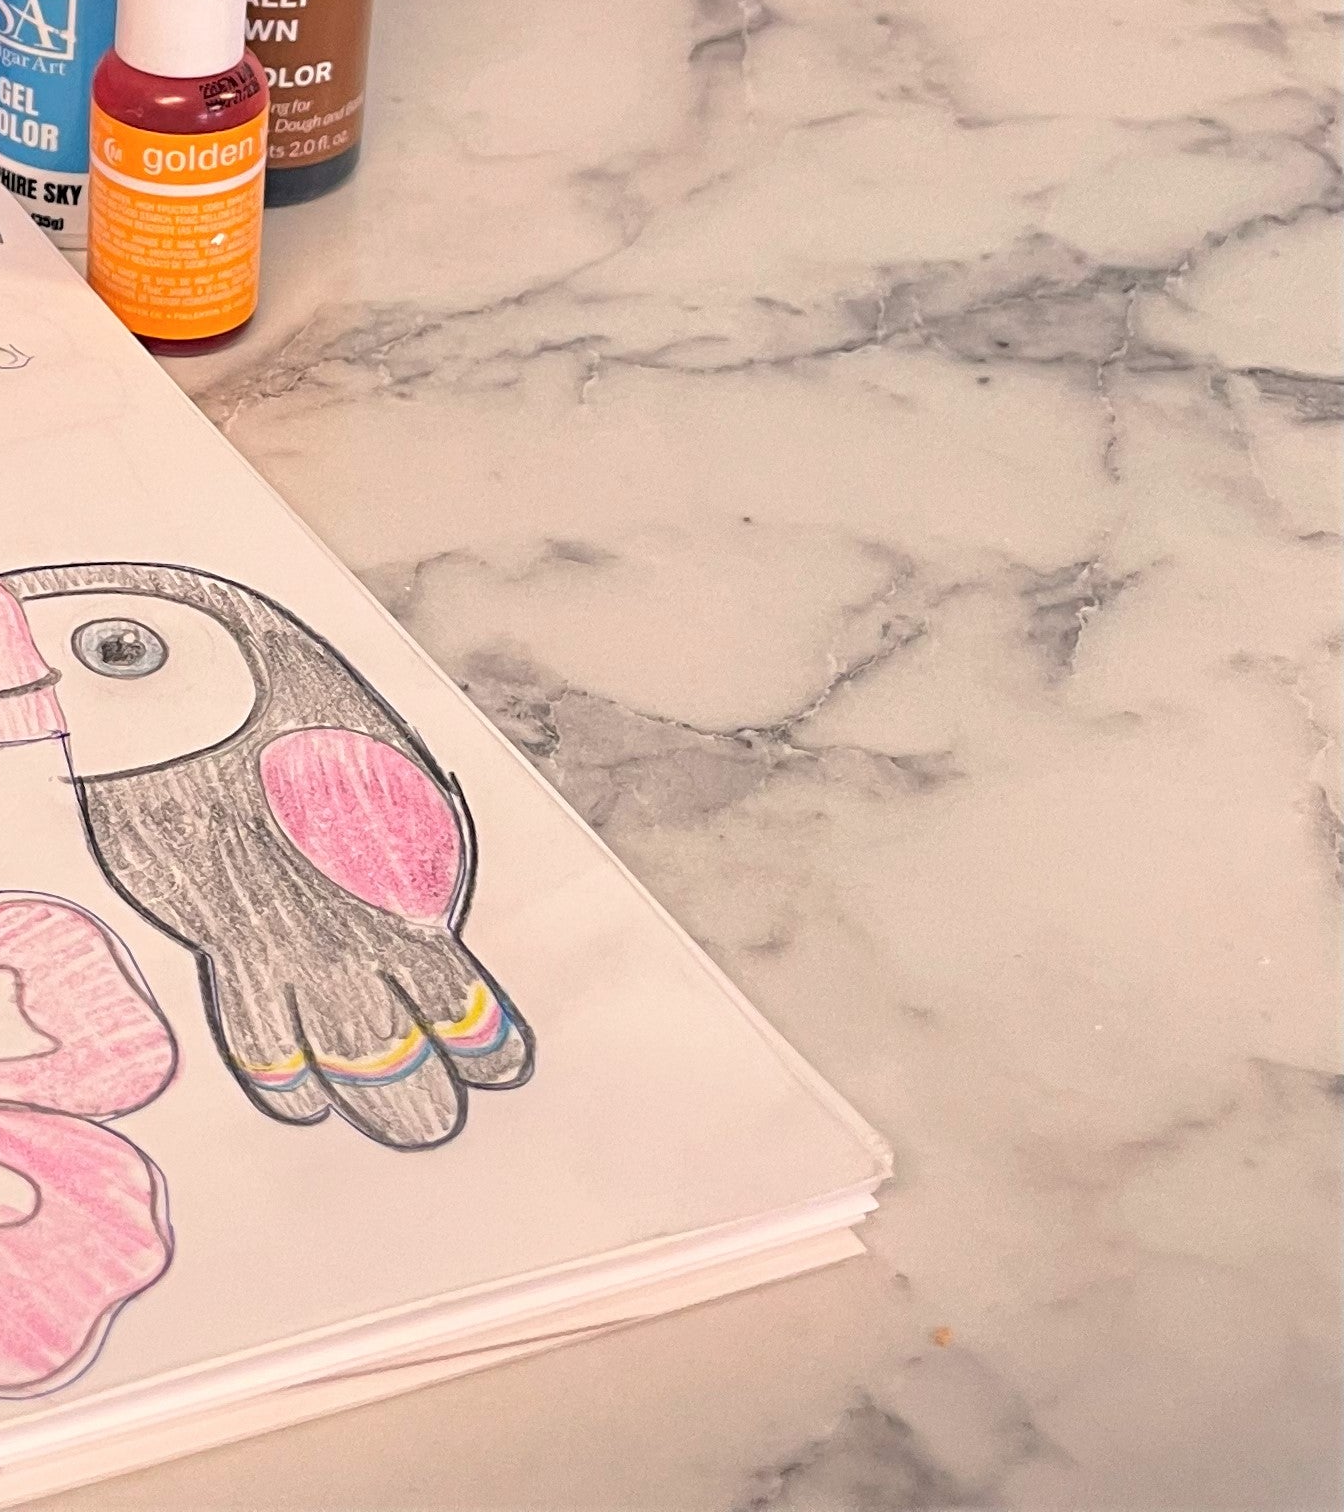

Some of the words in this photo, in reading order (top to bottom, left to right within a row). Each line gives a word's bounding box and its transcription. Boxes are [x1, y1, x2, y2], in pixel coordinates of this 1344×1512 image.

[31, 57, 68, 76] Art
[263, 61, 333, 89] OLOR
[275, 114, 322, 134] Dough
[142, 136, 253, 176] golden
[43, 183, 83, 206] SKY
